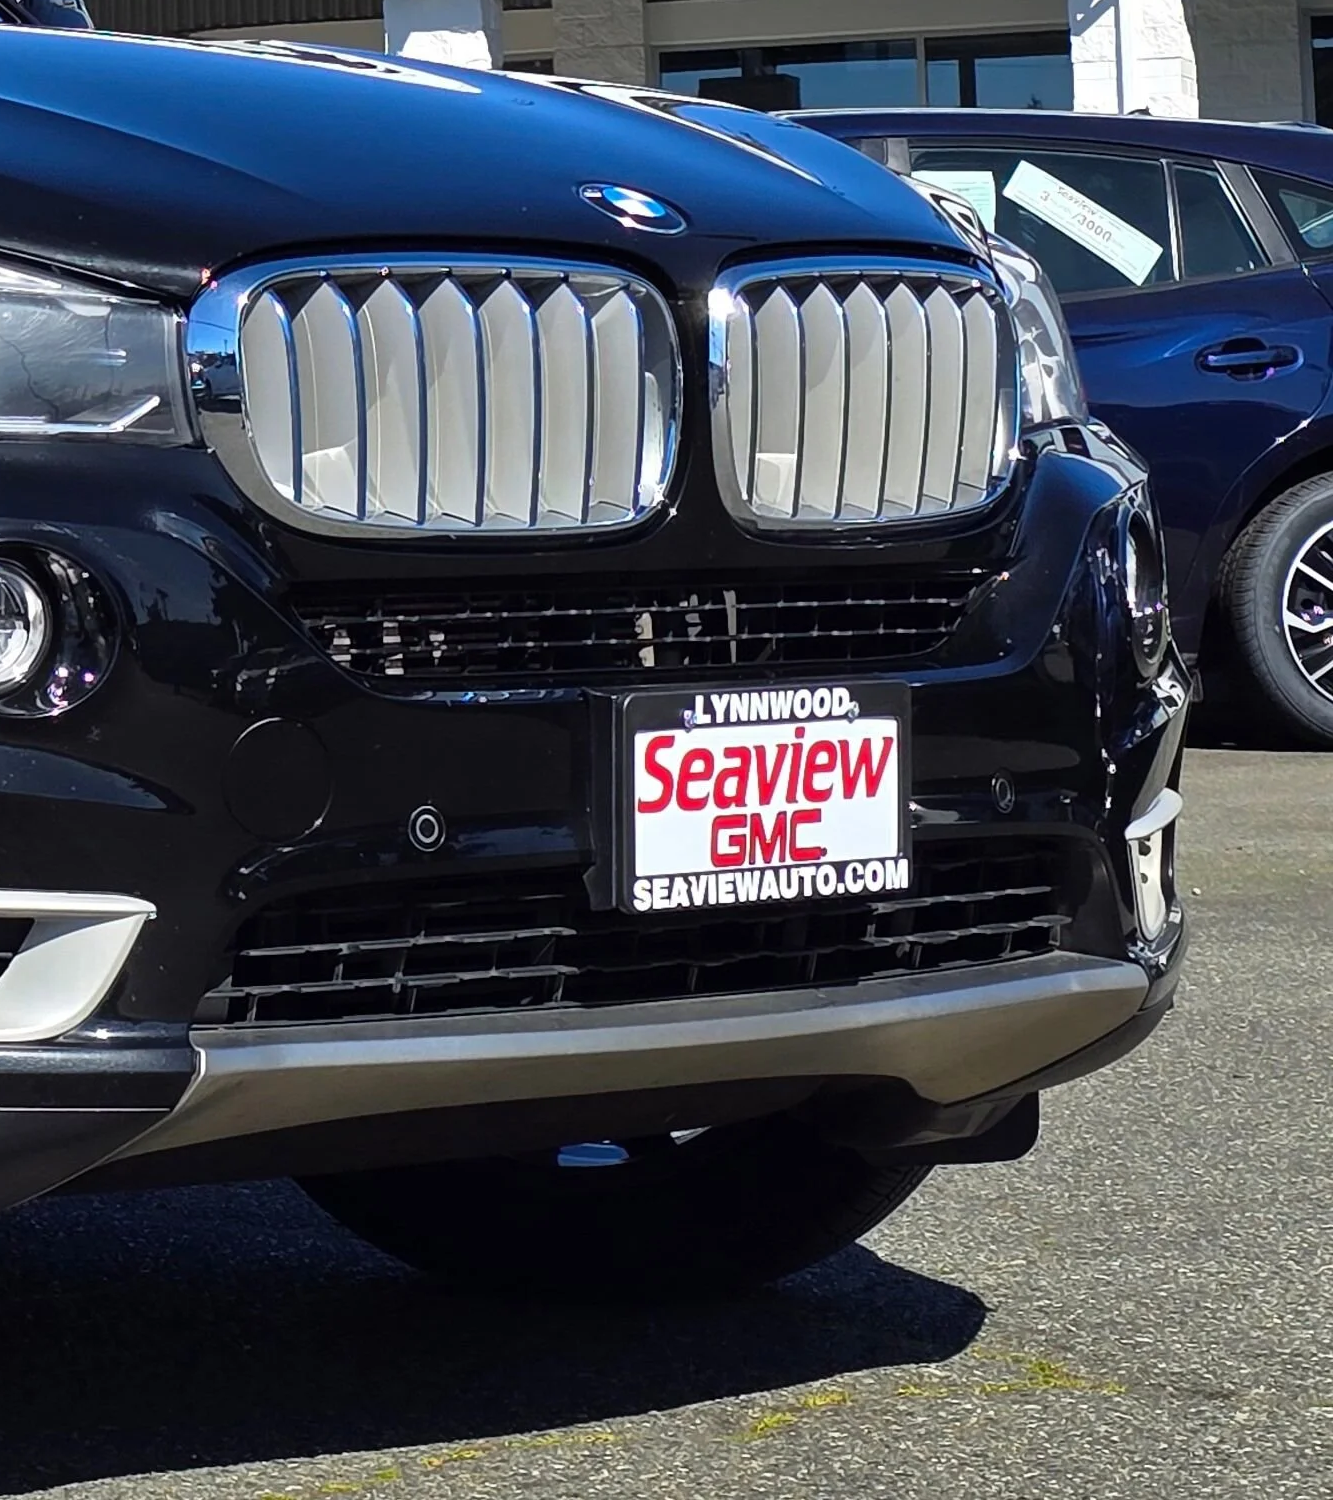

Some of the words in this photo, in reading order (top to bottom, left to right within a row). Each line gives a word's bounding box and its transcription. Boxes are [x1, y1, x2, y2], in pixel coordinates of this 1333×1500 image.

[695, 687, 851, 725] LYNNWOOD
[637, 726, 894, 814] Seaview
[710, 808, 827, 868] GMC
[632, 857, 910, 913] SEAVIEWAUTO.COM
